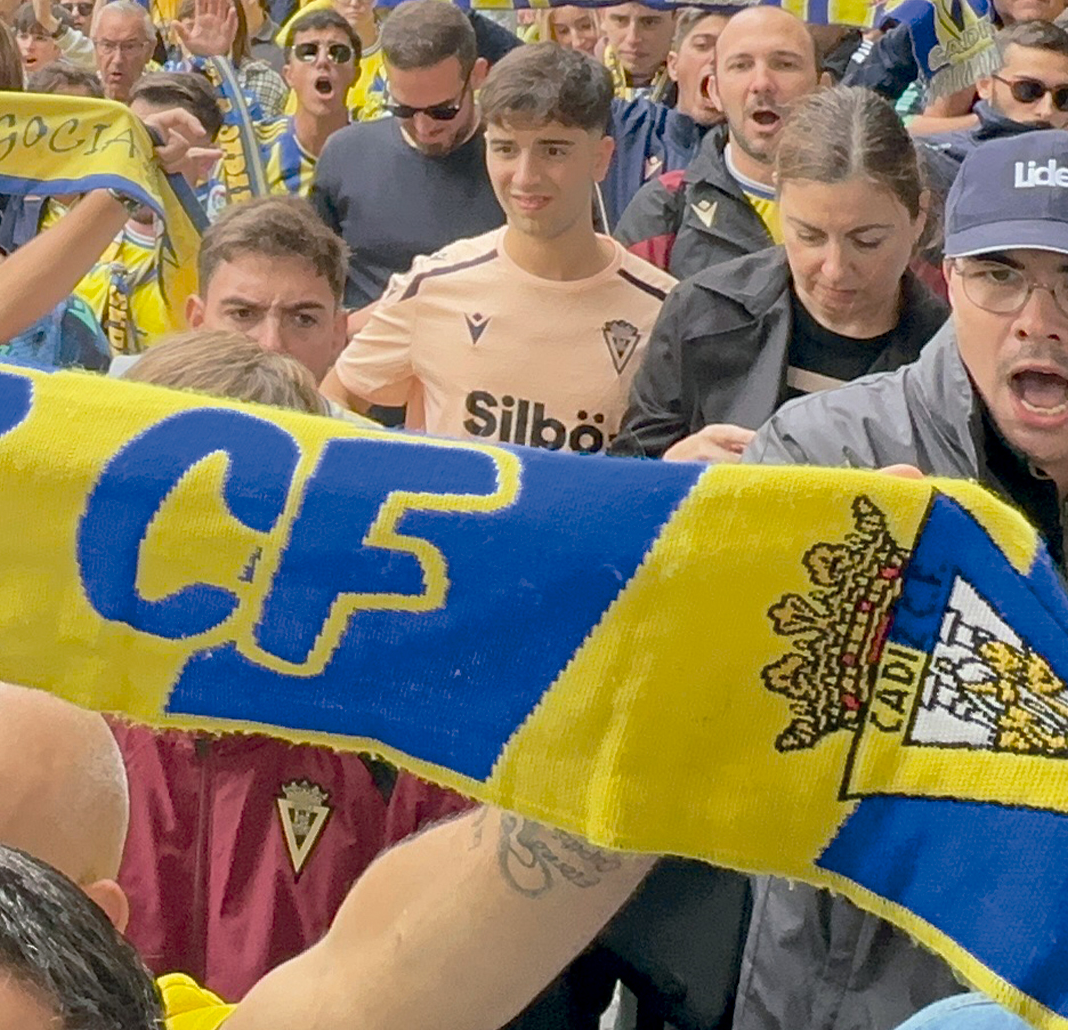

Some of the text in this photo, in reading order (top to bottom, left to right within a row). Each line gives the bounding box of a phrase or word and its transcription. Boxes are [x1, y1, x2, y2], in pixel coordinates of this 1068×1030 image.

[1015, 159, 1068, 187] Lide
[463, 389, 618, 453] Silbö
[76, 407, 521, 676] CF
